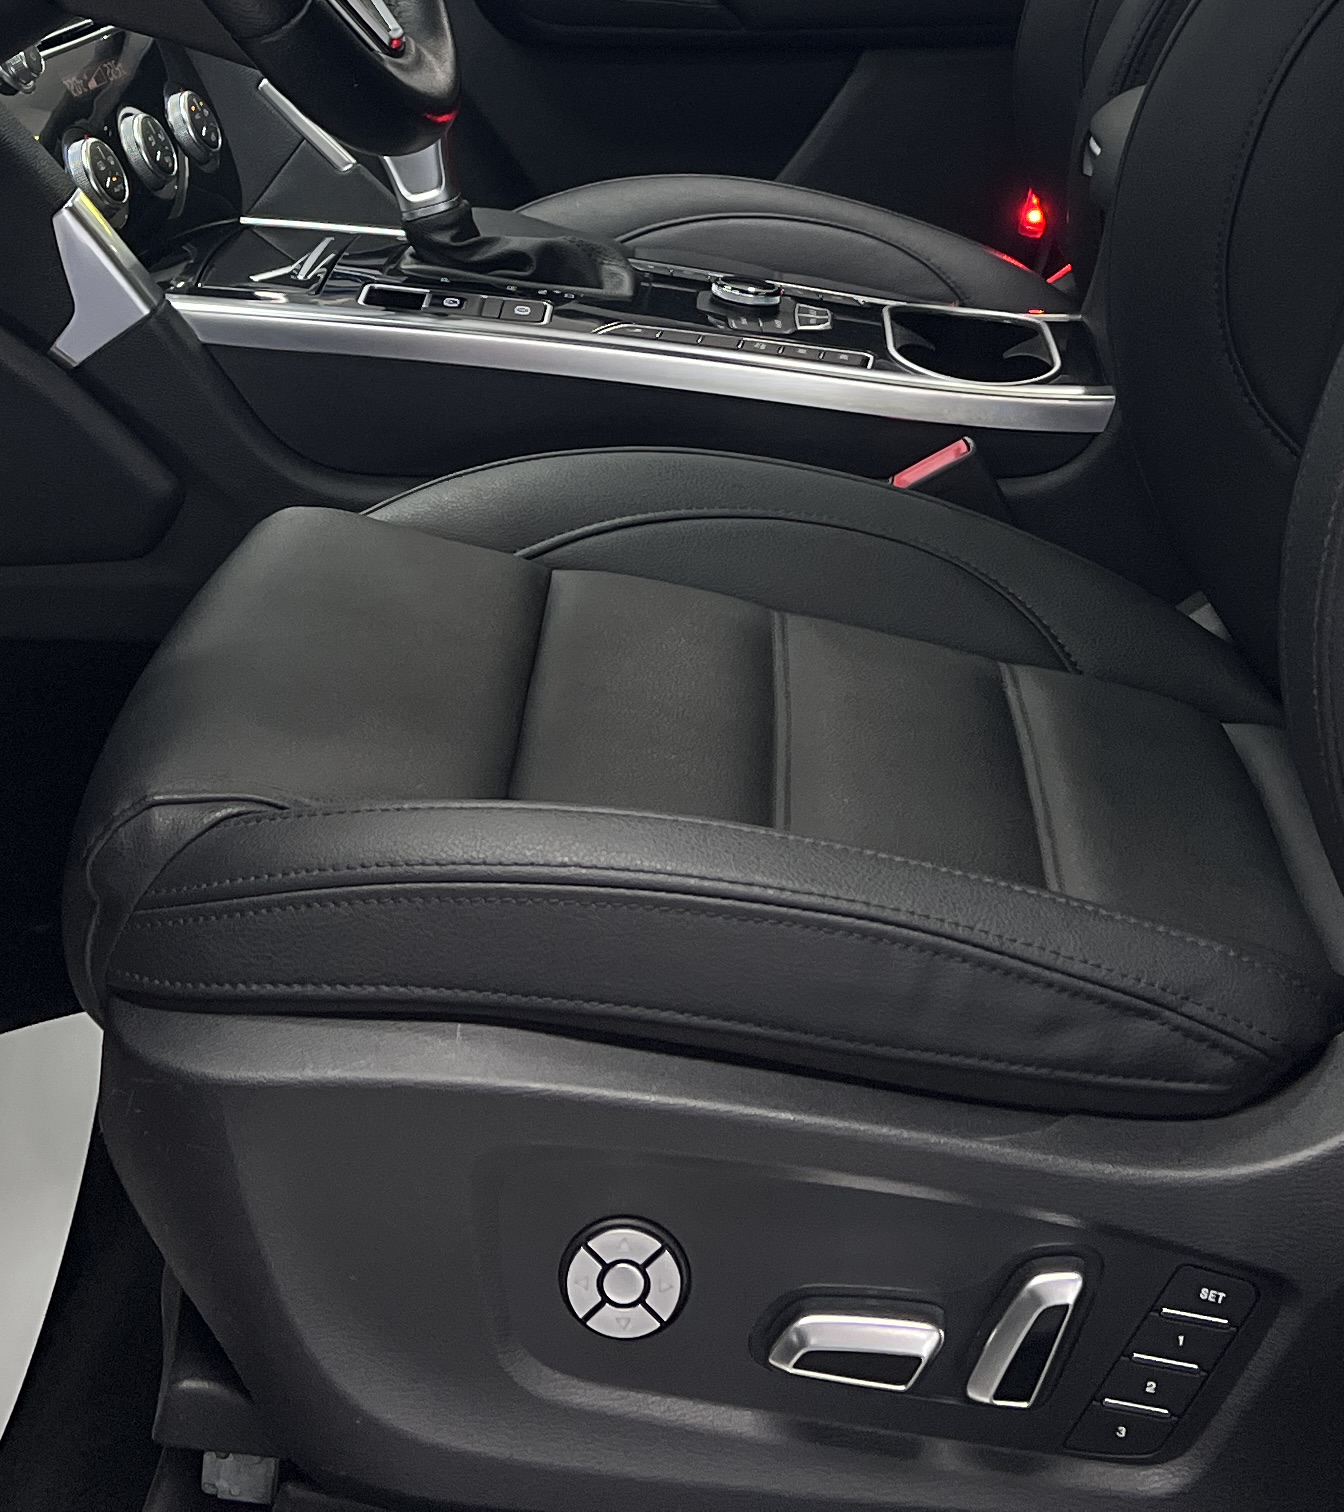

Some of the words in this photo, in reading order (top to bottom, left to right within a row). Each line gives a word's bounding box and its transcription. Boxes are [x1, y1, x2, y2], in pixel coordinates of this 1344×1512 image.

[1199, 1287, 1227, 1304] SET
[1177, 1335, 1185, 1347] 1
[1144, 1381, 1157, 1393] 2
[1114, 1426, 1127, 1438] 3
